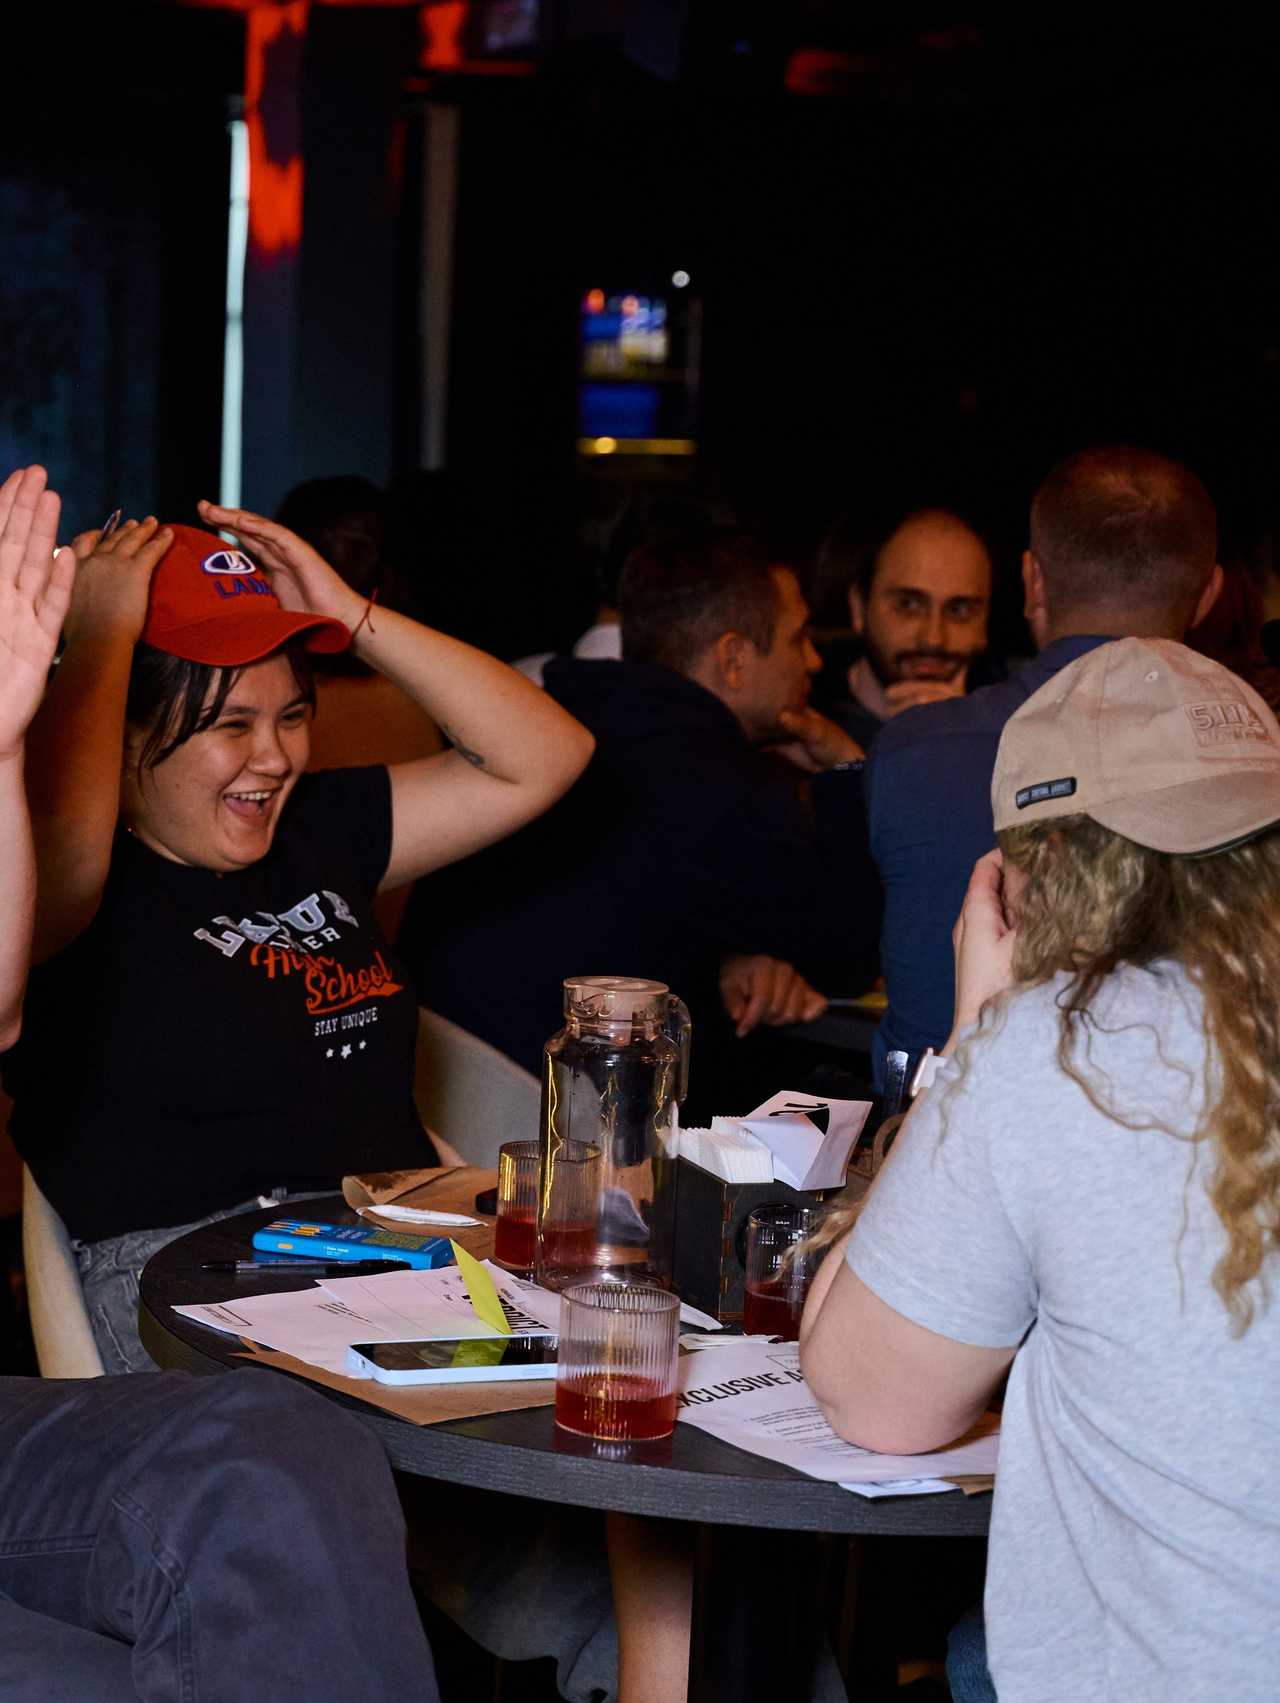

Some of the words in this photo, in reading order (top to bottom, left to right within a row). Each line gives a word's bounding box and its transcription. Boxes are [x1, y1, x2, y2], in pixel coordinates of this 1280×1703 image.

[305, 950, 394, 1011] School
[314, 1018, 338, 1036] STAY
[341, 1006, 378, 1030] UNIQUE
[461, 1294, 551, 1330] DICT
